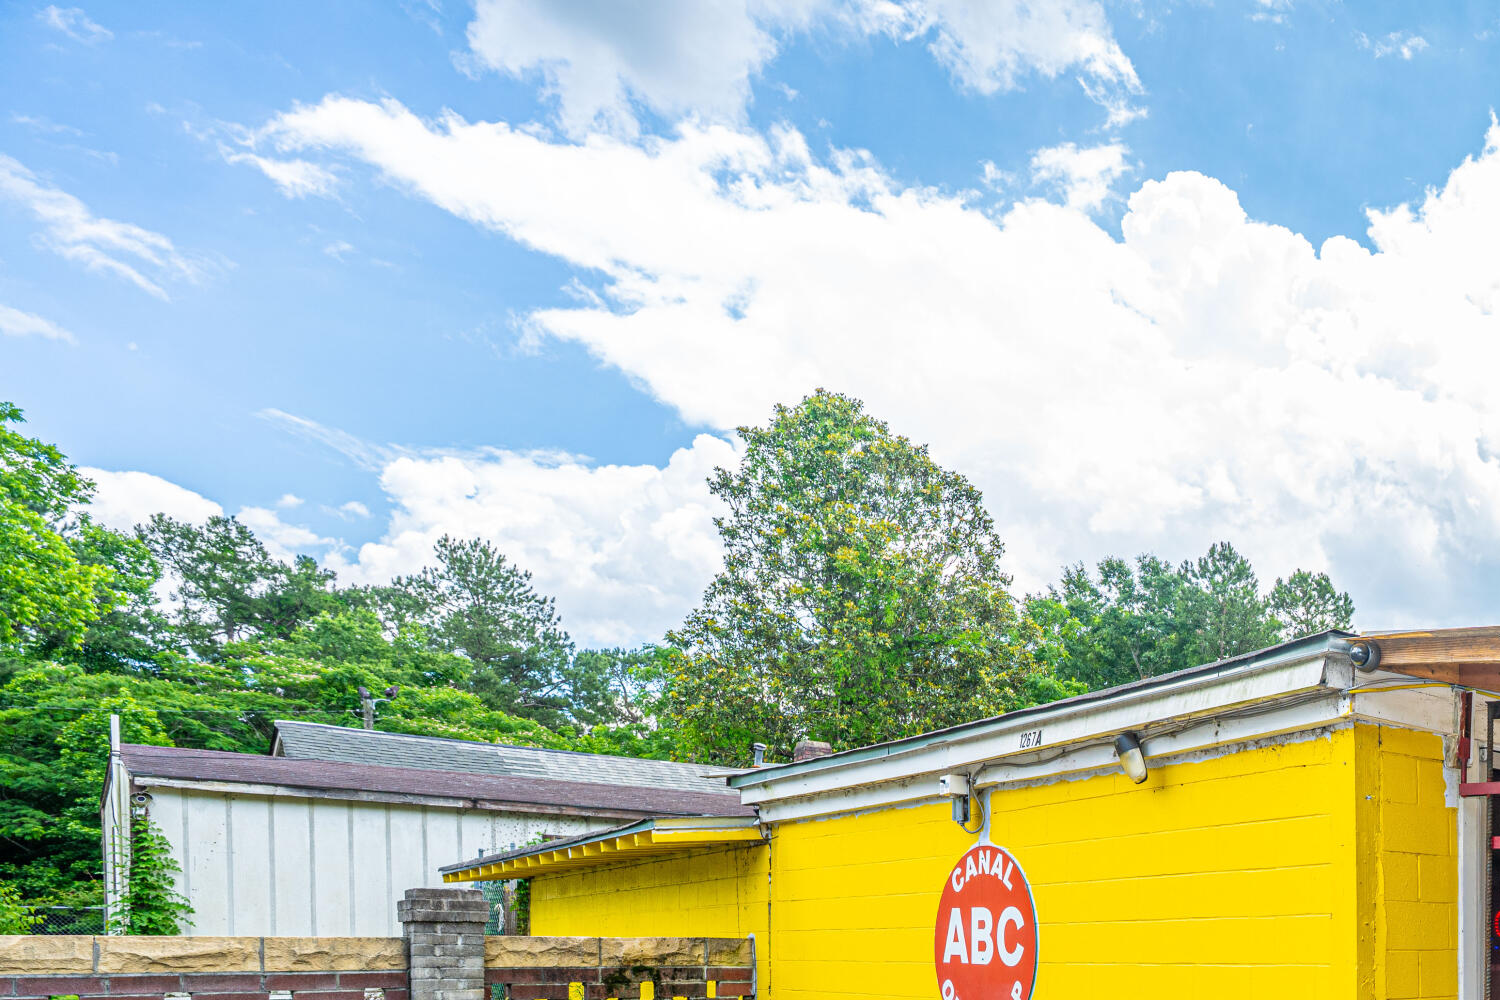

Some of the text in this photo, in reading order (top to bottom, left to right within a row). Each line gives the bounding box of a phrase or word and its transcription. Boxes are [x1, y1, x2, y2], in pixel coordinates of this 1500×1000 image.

[1019, 730, 1042, 748] 1267A
[951, 849, 1014, 893] CANAL
[943, 905, 1025, 967] ABC
